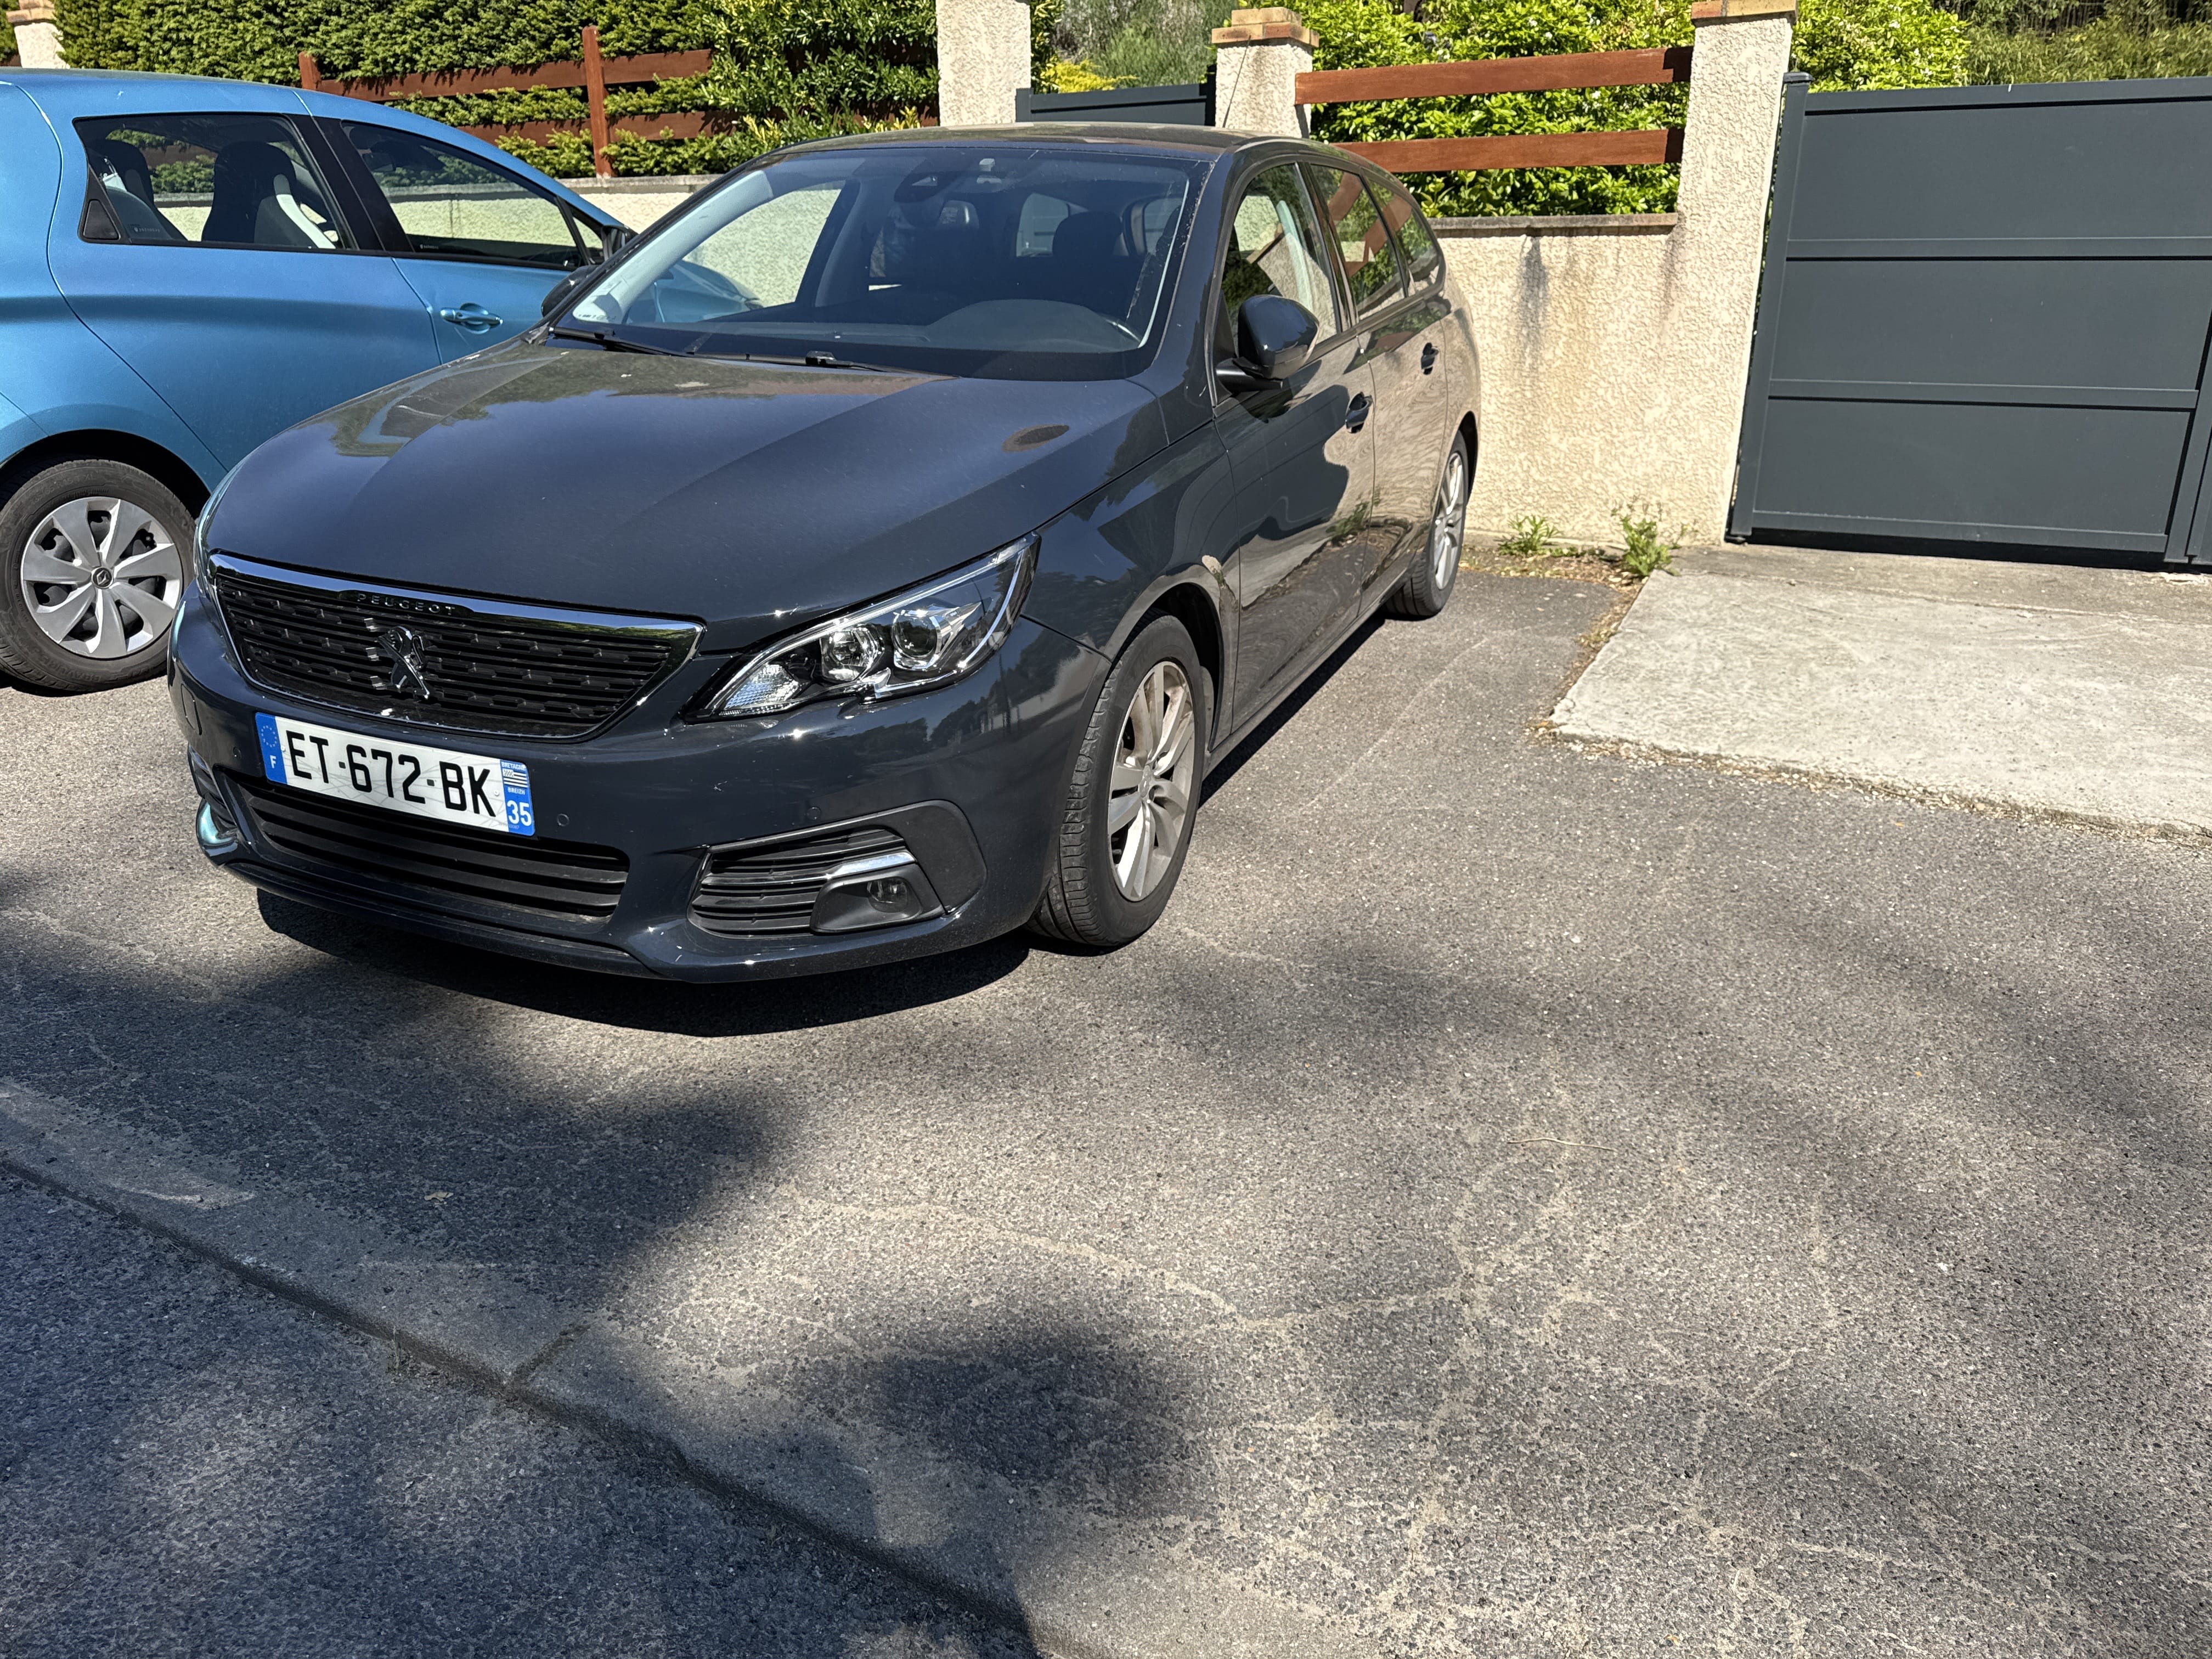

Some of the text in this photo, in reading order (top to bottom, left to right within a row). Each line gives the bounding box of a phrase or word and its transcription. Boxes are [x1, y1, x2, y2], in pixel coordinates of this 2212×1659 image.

[357, 592, 455, 615] PEUGEOT
[269, 755, 276, 769] F
[501, 761, 527, 771] BRETAGNE
[286, 730, 496, 817] ET-672-BK
[508, 787, 525, 795] BREIZH
[507, 800, 532, 826] 35
